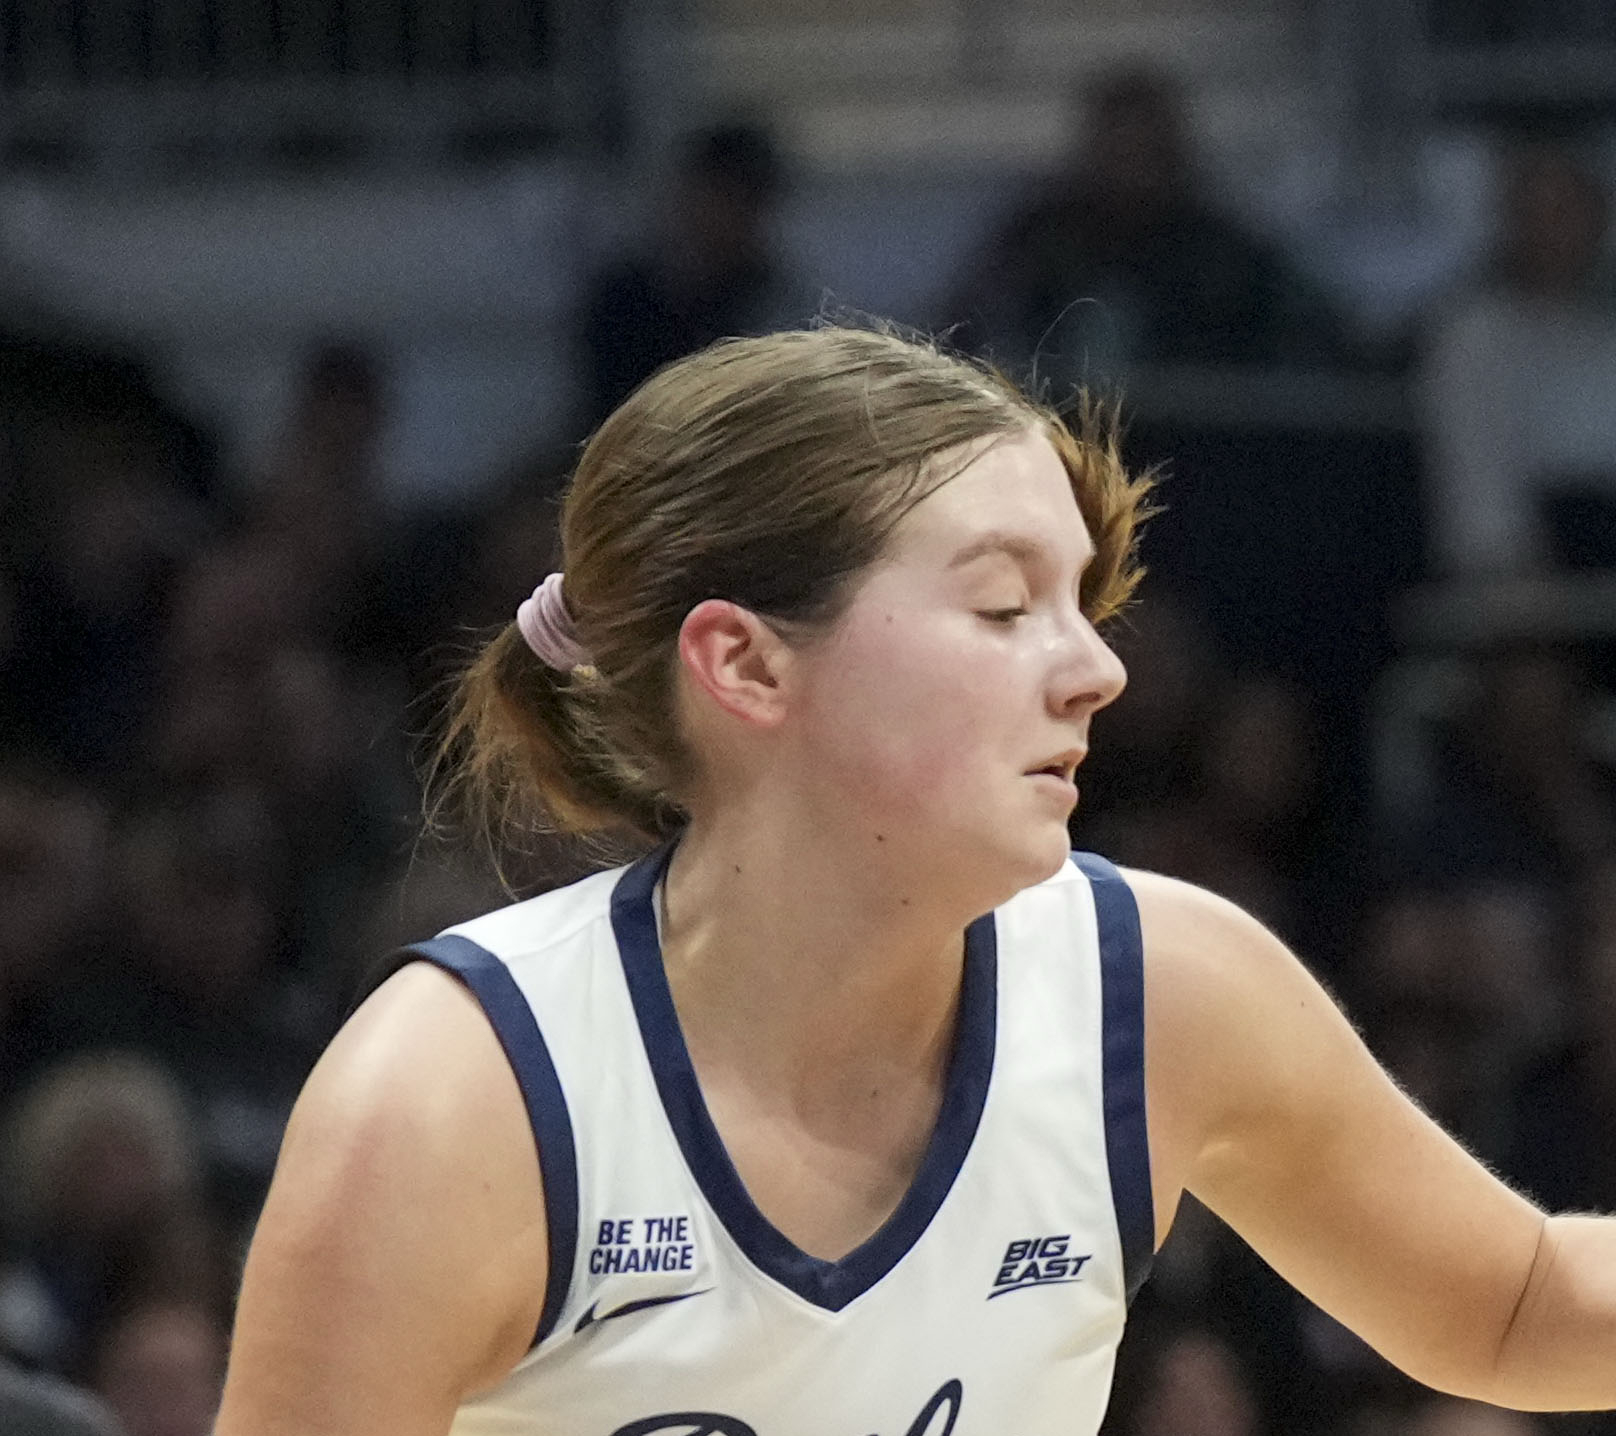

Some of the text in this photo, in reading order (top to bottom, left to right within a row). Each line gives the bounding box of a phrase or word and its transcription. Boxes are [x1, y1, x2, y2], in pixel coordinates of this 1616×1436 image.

[598, 1217, 688, 1245] BE THE
[590, 1244, 694, 1275] CHANGE
[1003, 1235, 1071, 1263] BIG
[993, 1255, 1092, 1287] EAST
